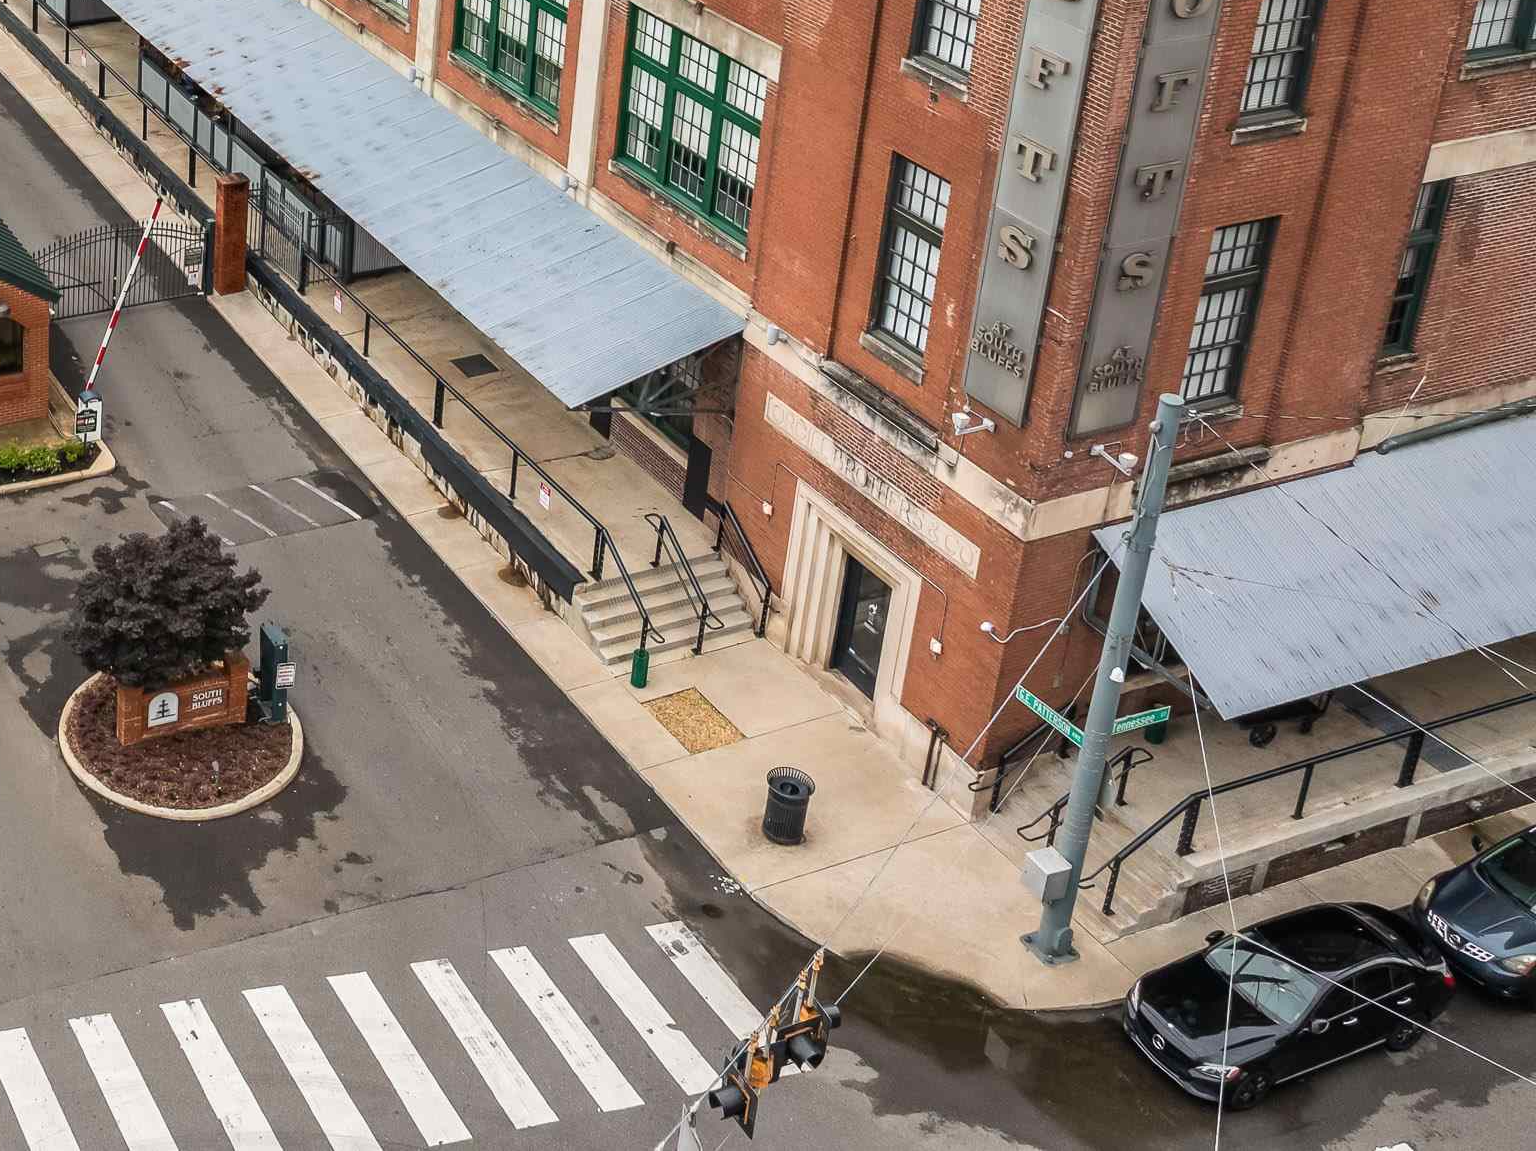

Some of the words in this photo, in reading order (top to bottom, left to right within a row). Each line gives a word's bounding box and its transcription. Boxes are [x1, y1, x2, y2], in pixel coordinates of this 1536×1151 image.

[991, 320, 1013, 338] AT
[975, 326, 1024, 363] SOUTH
[970, 338, 1024, 379] BLUFFS
[1093, 356, 1144, 380] SOUTH
[191, 696, 223, 710] BLUFFS
[192, 689, 223, 703] SOUTH
[1032, 699, 1071, 736] PATTERSON
